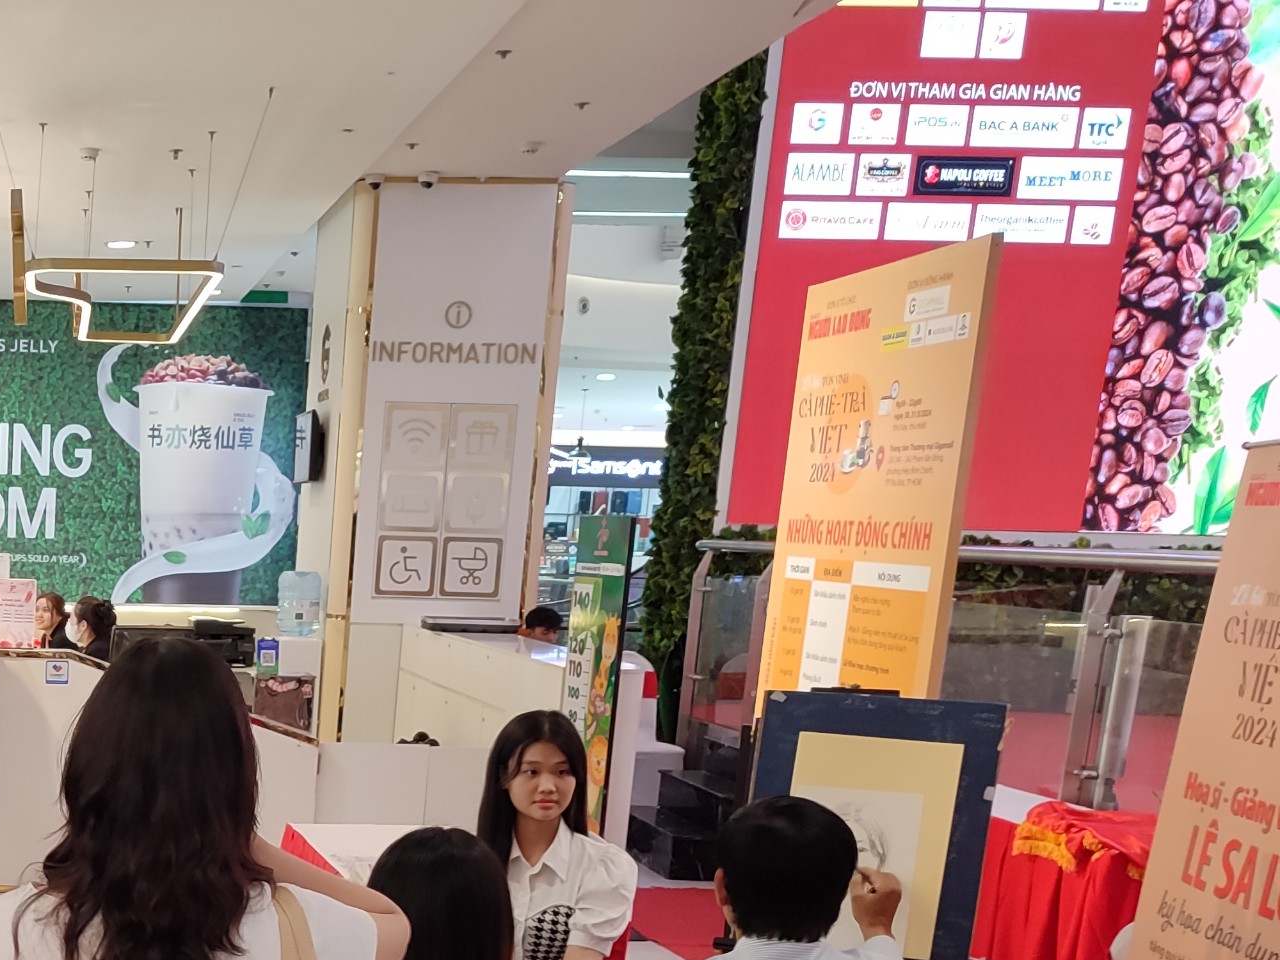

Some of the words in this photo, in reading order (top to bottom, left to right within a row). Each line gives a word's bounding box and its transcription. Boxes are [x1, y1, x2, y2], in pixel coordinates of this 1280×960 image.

[850, 81, 889, 99] ĐƠN
[891, 83, 906, 102] VỊ
[909, 84, 955, 99] THAM
[959, 84, 986, 100] GIA
[990, 83, 1030, 100] GIAN
[1033, 82, 1081, 101] HÀNG
[979, 120, 1007, 132] BAC
[1009, 121, 1018, 132] A
[1022, 121, 1060, 132] BANK
[940, 167, 971, 182] NAPOLI
[972, 167, 1006, 181] COFFEE
[1025, 175, 1066, 187] MEET
[1069, 170, 1113, 182] MORE
[9, 339, 60, 354] JELLY
[372, 340, 538, 365] INFORMATION
[147, 423, 255, 451] 书亦烧仙草
[786, 514, 825, 546] NHỮNG
[825, 519, 855, 554] HOẠT
[855, 515, 890, 556] ĐỘNG
[890, 516, 933, 551] CHÍNH
[28, 554, 49, 564] SOLD
[49, 555, 57, 564] A
[573, 590, 590, 609] 140
[1224, 609, 1246, 646] CÀ
[569, 637, 585, 656] 120
[568, 659, 582, 678] 110
[568, 685, 580, 700] 100
[1231, 712, 1278, 751] 2024
[1184, 771, 1210, 814] Họa
[1230, 785, 1276, 835] Giảng
[1181, 818, 1219, 893] LÊ
[1213, 838, 1259, 911] SA
[1258, 853, 1280, 921] L
[1204, 916, 1242, 955] chân
